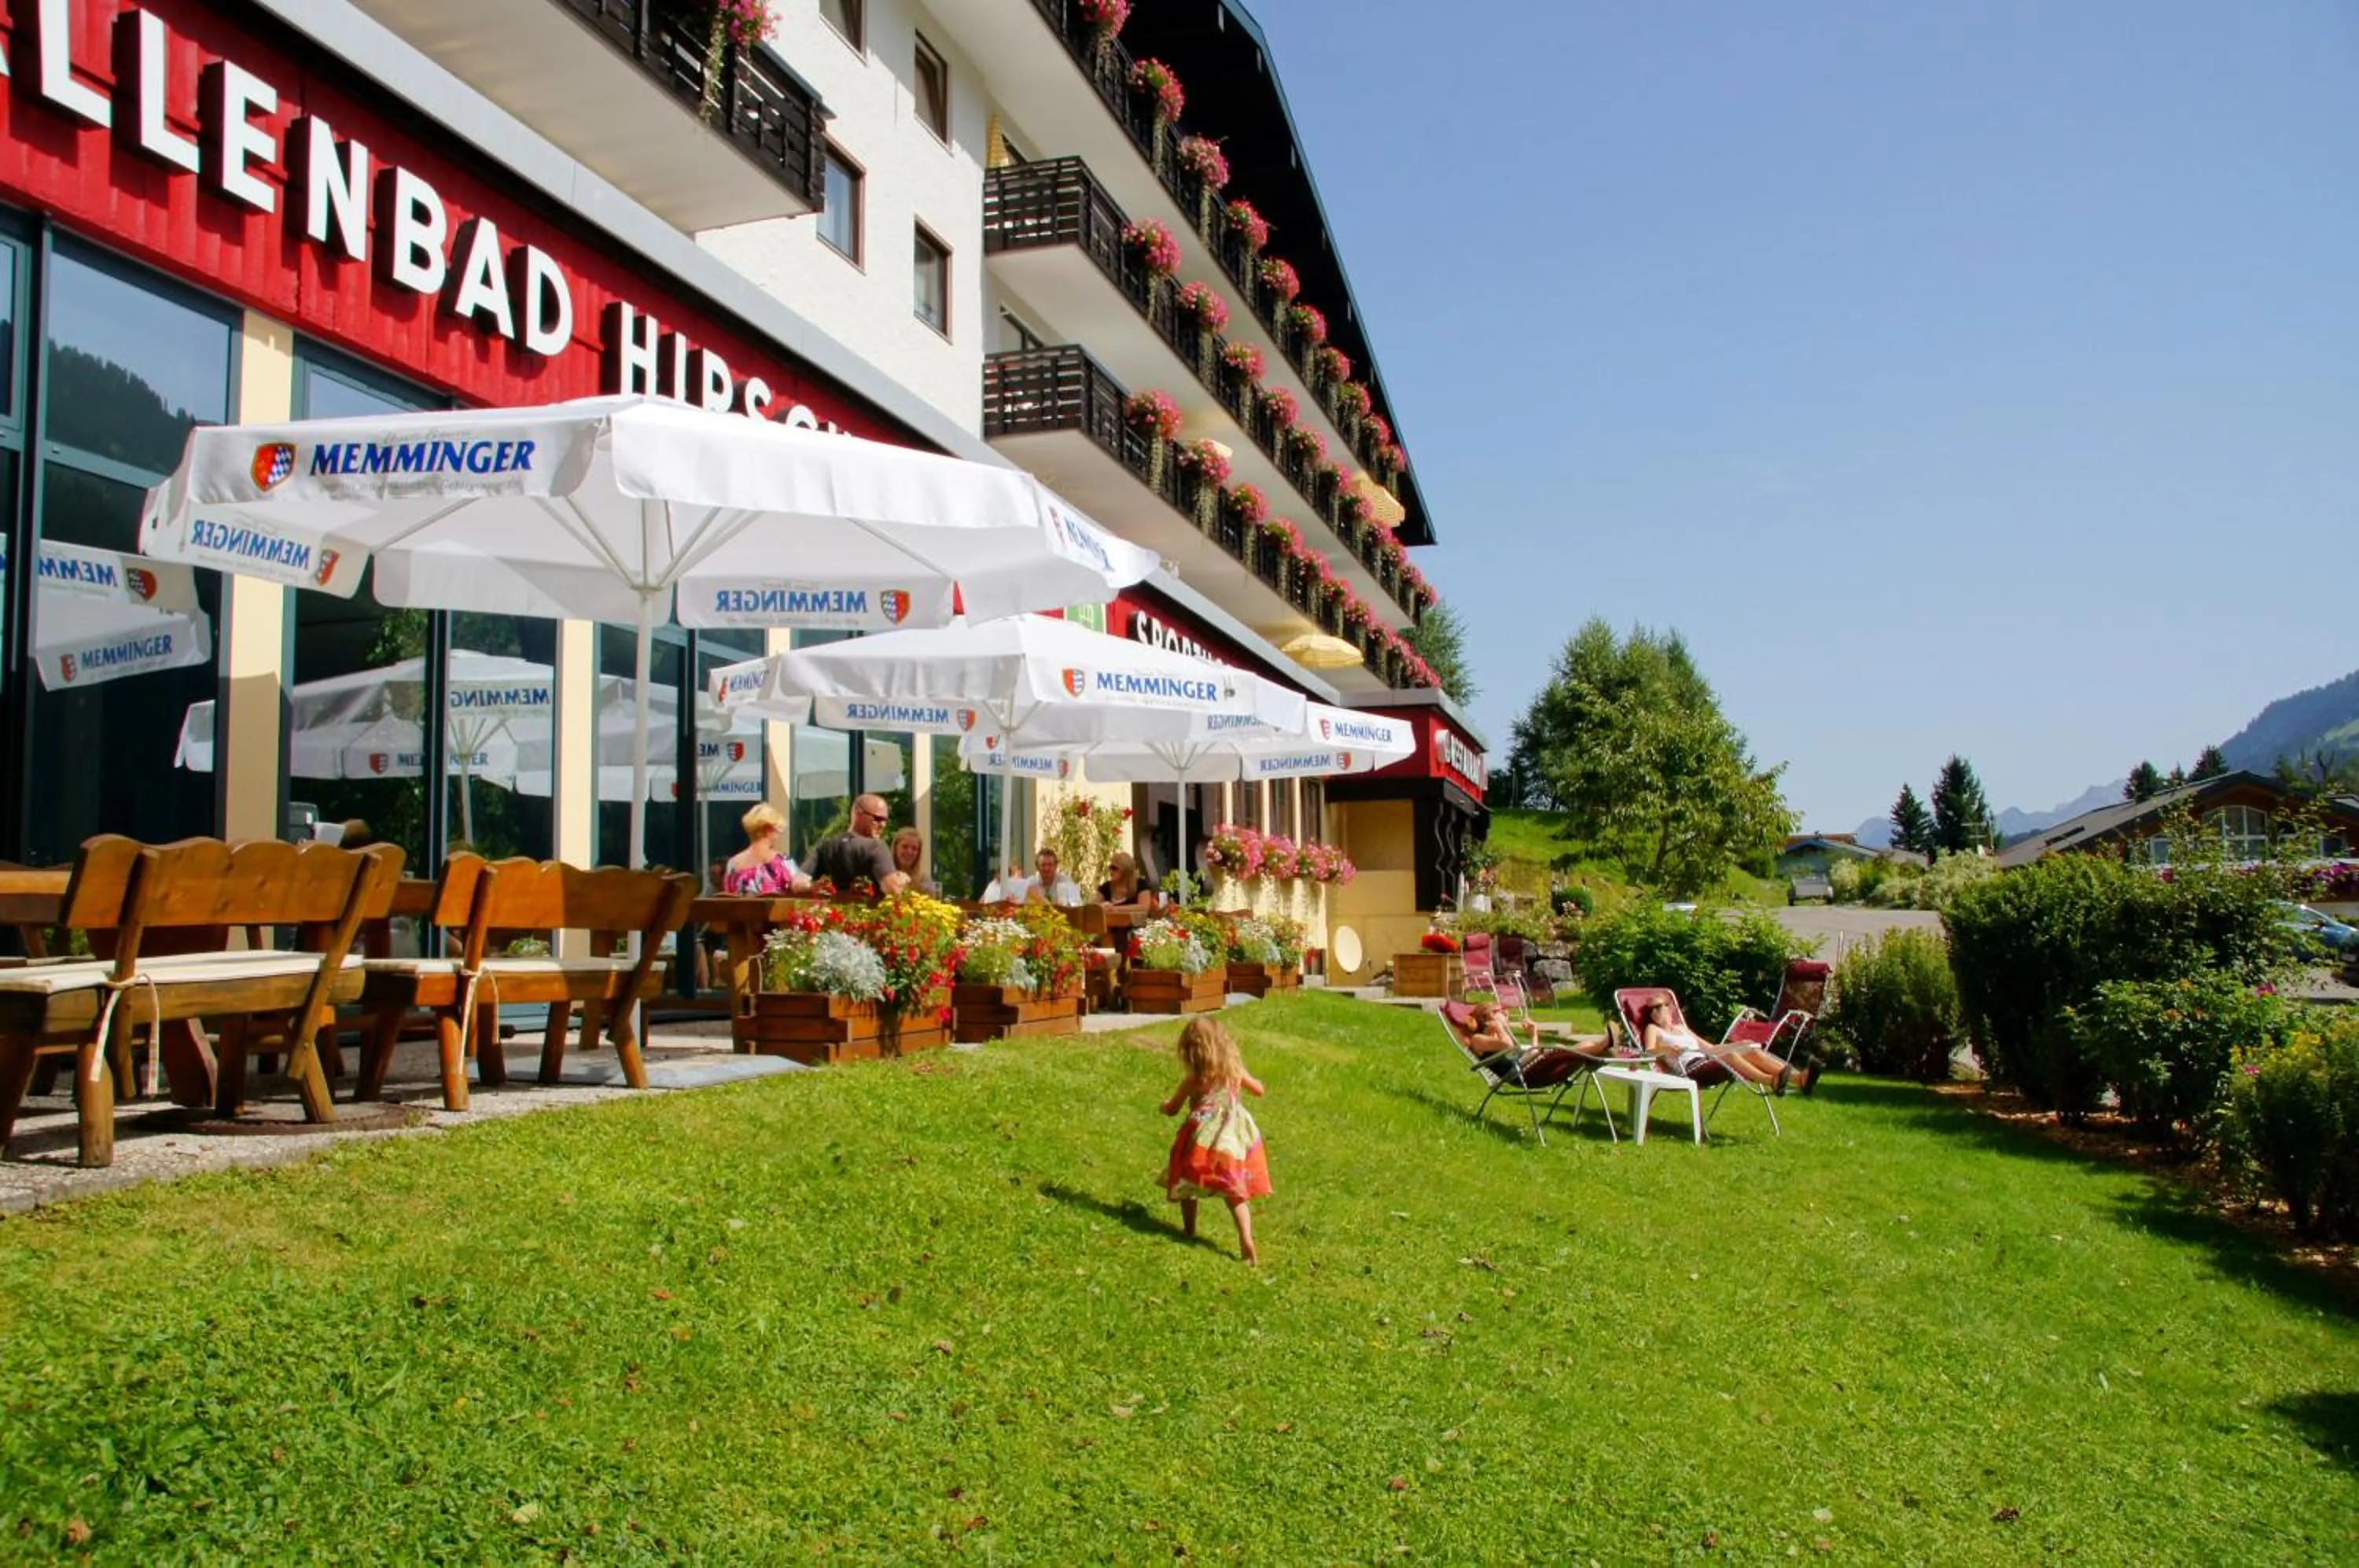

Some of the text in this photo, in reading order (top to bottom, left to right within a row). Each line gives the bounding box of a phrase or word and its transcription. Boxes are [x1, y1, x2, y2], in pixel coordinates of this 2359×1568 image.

[0, 0, 852, 437] LLENBAD HIRS
[310, 440, 535, 476] MEMMINGER
[81, 635, 173, 669] MEMMINGER
[1097, 672, 1217, 701] MEMMINGER
[1334, 721, 1393, 744] MEMMINGER
